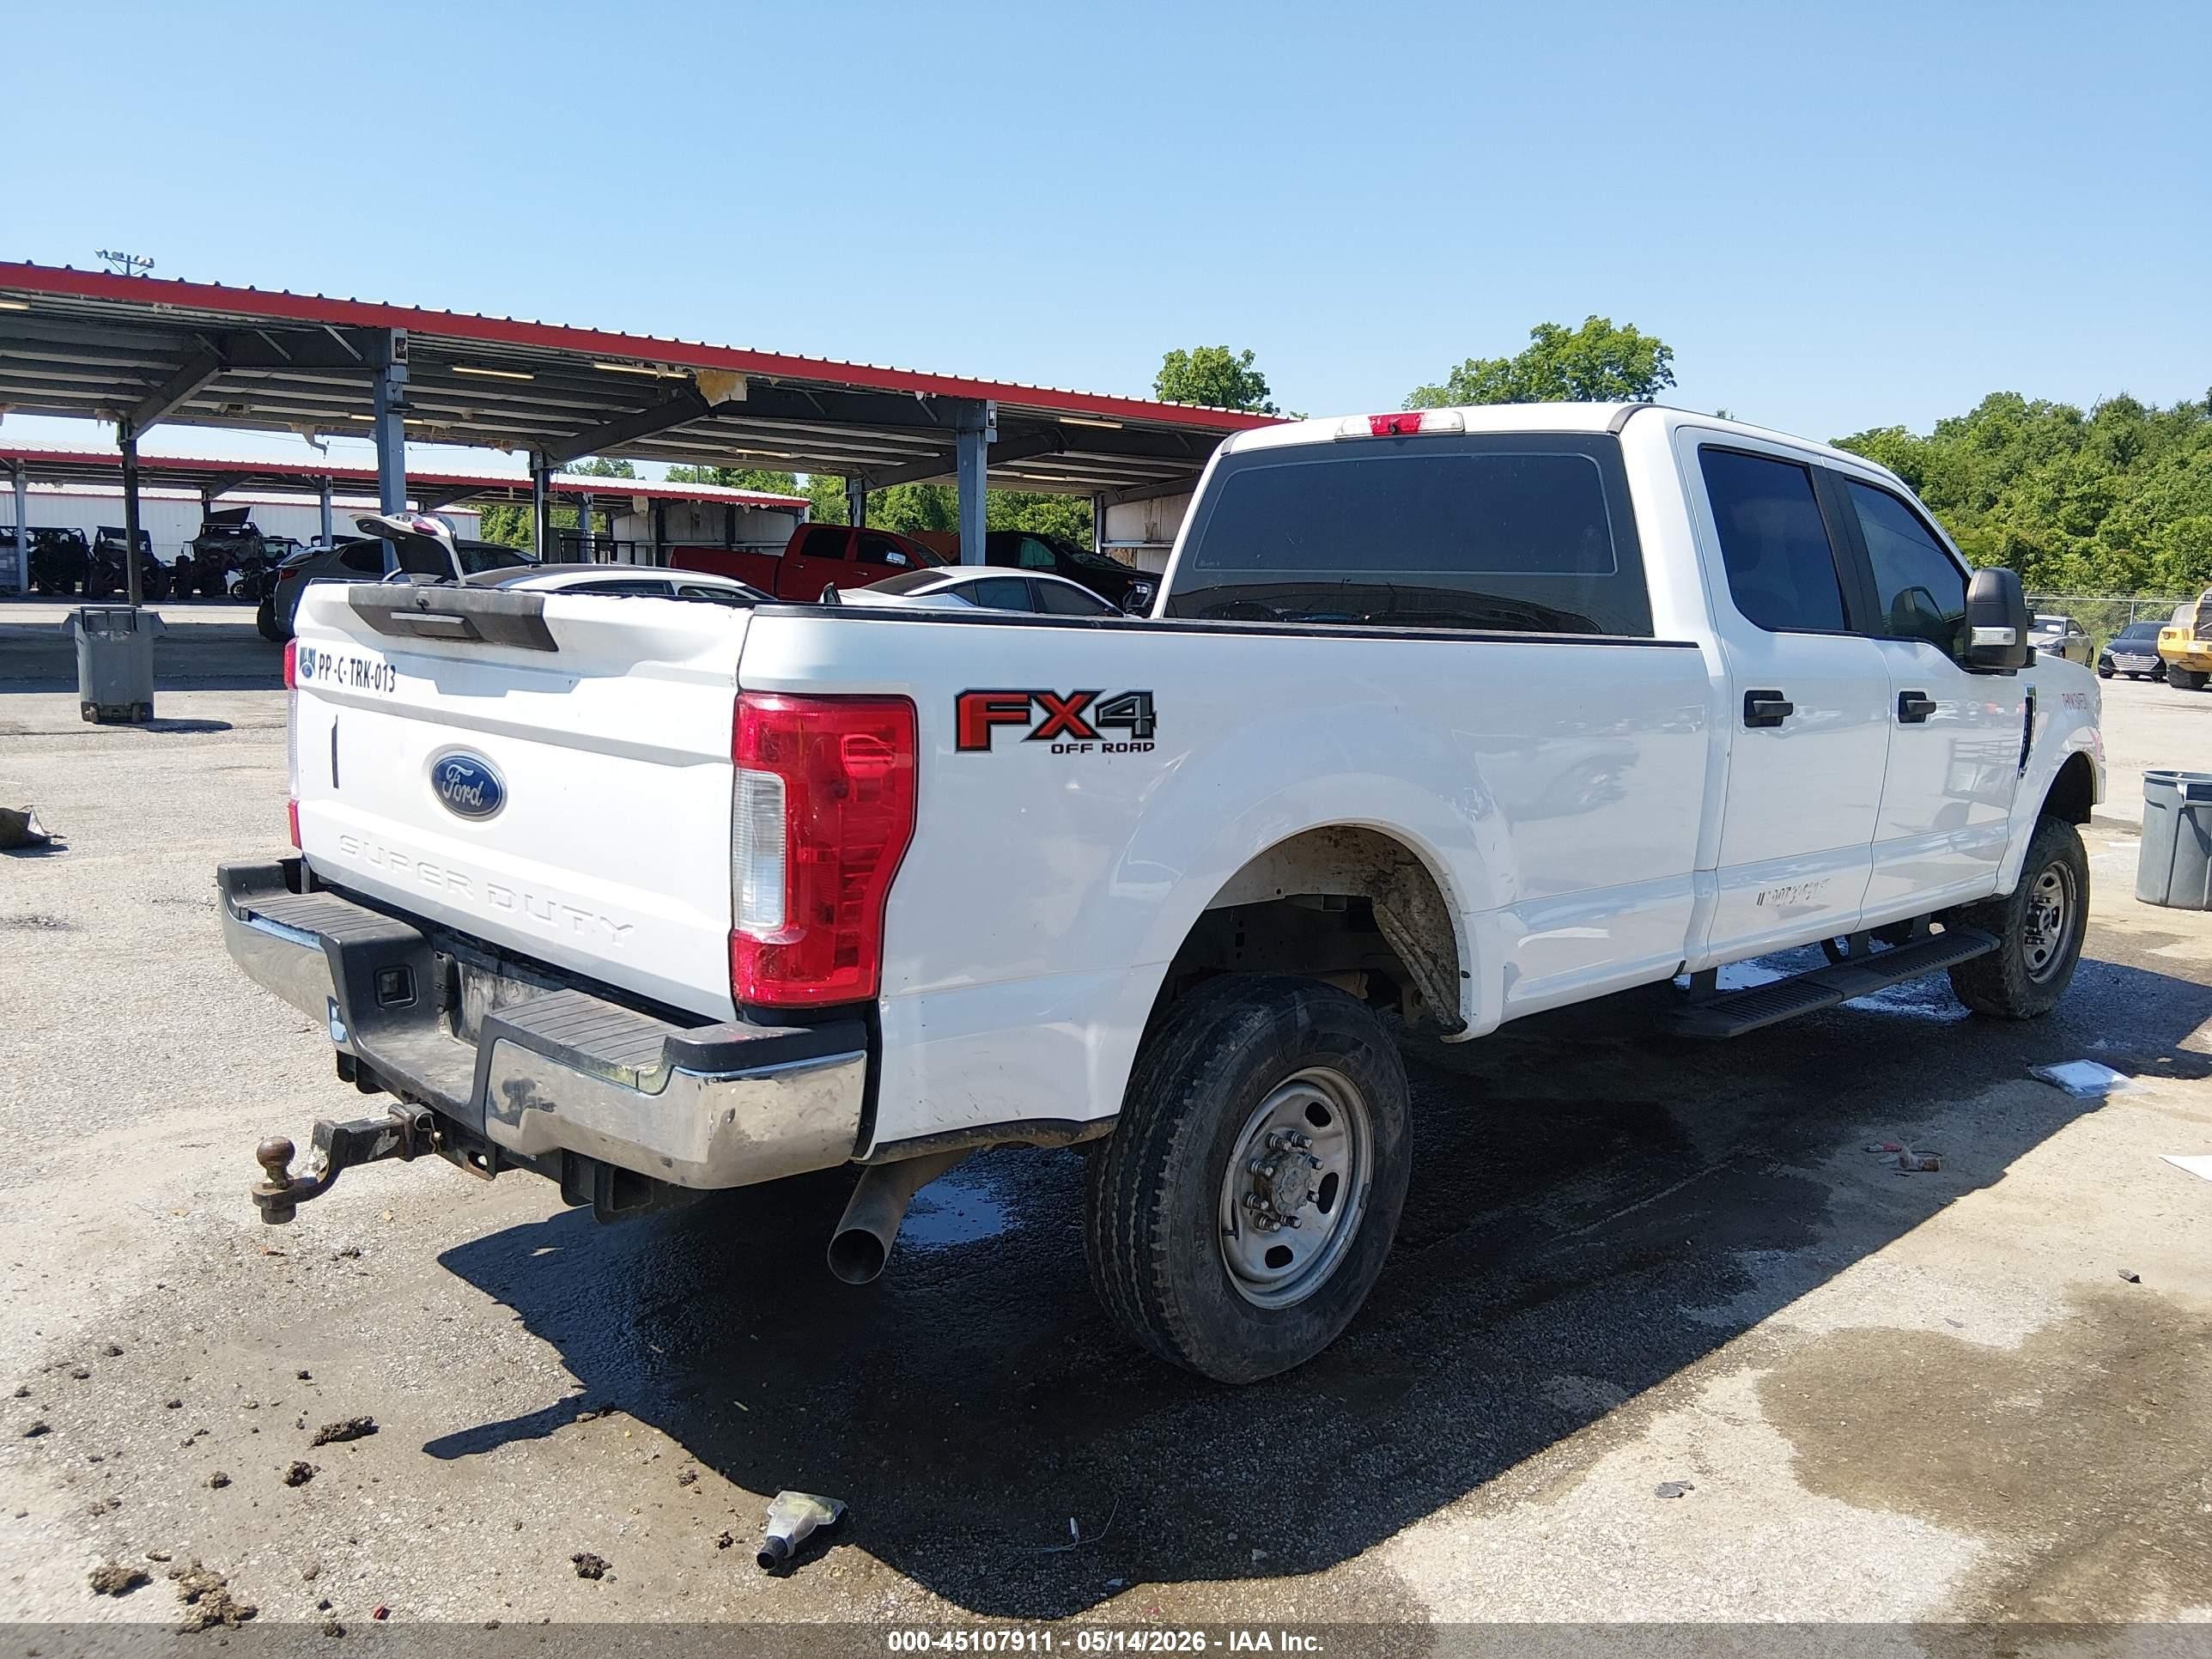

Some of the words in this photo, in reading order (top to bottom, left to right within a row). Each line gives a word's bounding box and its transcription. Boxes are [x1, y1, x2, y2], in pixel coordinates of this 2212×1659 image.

[954, 688, 1158, 753] FX4
[1051, 743, 1094, 754] OFF
[1101, 742, 1155, 754] ROAD
[442, 763, 484, 807] Ford
[339, 834, 475, 901] SUPER
[487, 882, 635, 948] DUTY
